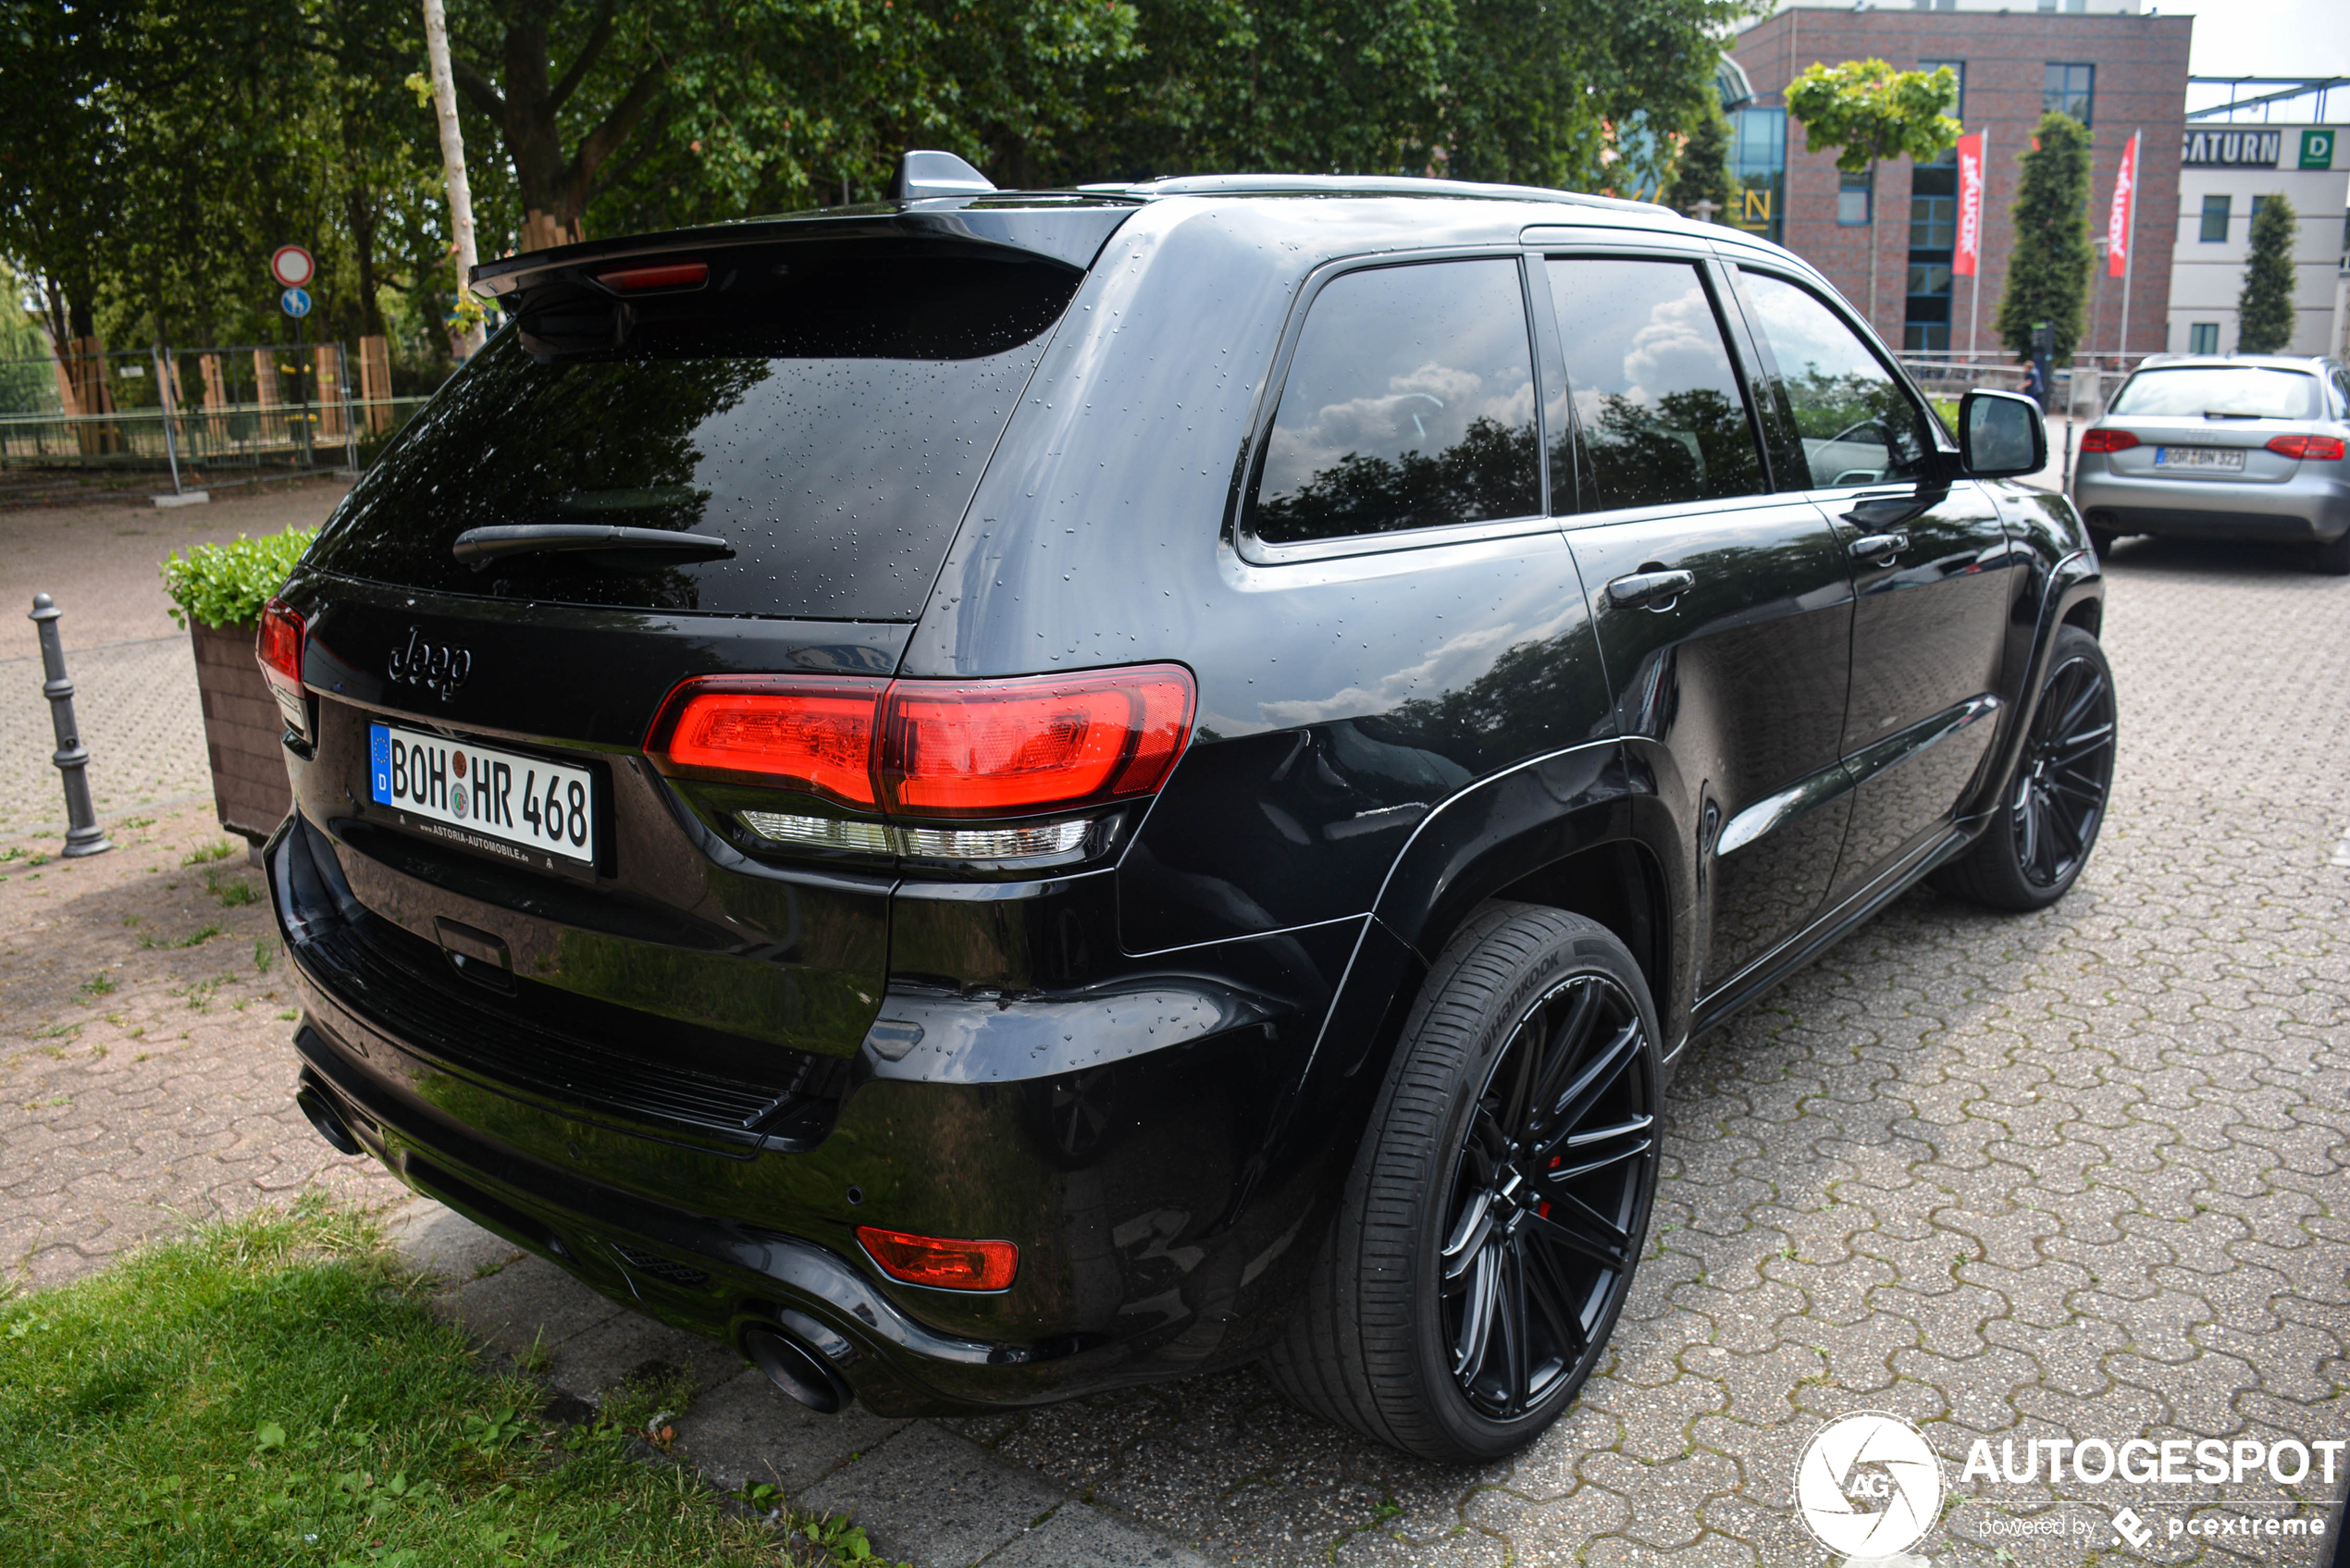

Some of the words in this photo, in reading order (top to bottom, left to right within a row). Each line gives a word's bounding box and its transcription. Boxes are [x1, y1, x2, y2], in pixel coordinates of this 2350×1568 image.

[2308, 136, 2329, 156] D
[388, 624, 471, 702] Jeep
[378, 773, 386, 791] D
[391, 738, 448, 811] BOH
[472, 756, 513, 828] HR
[523, 770, 588, 847] 468
